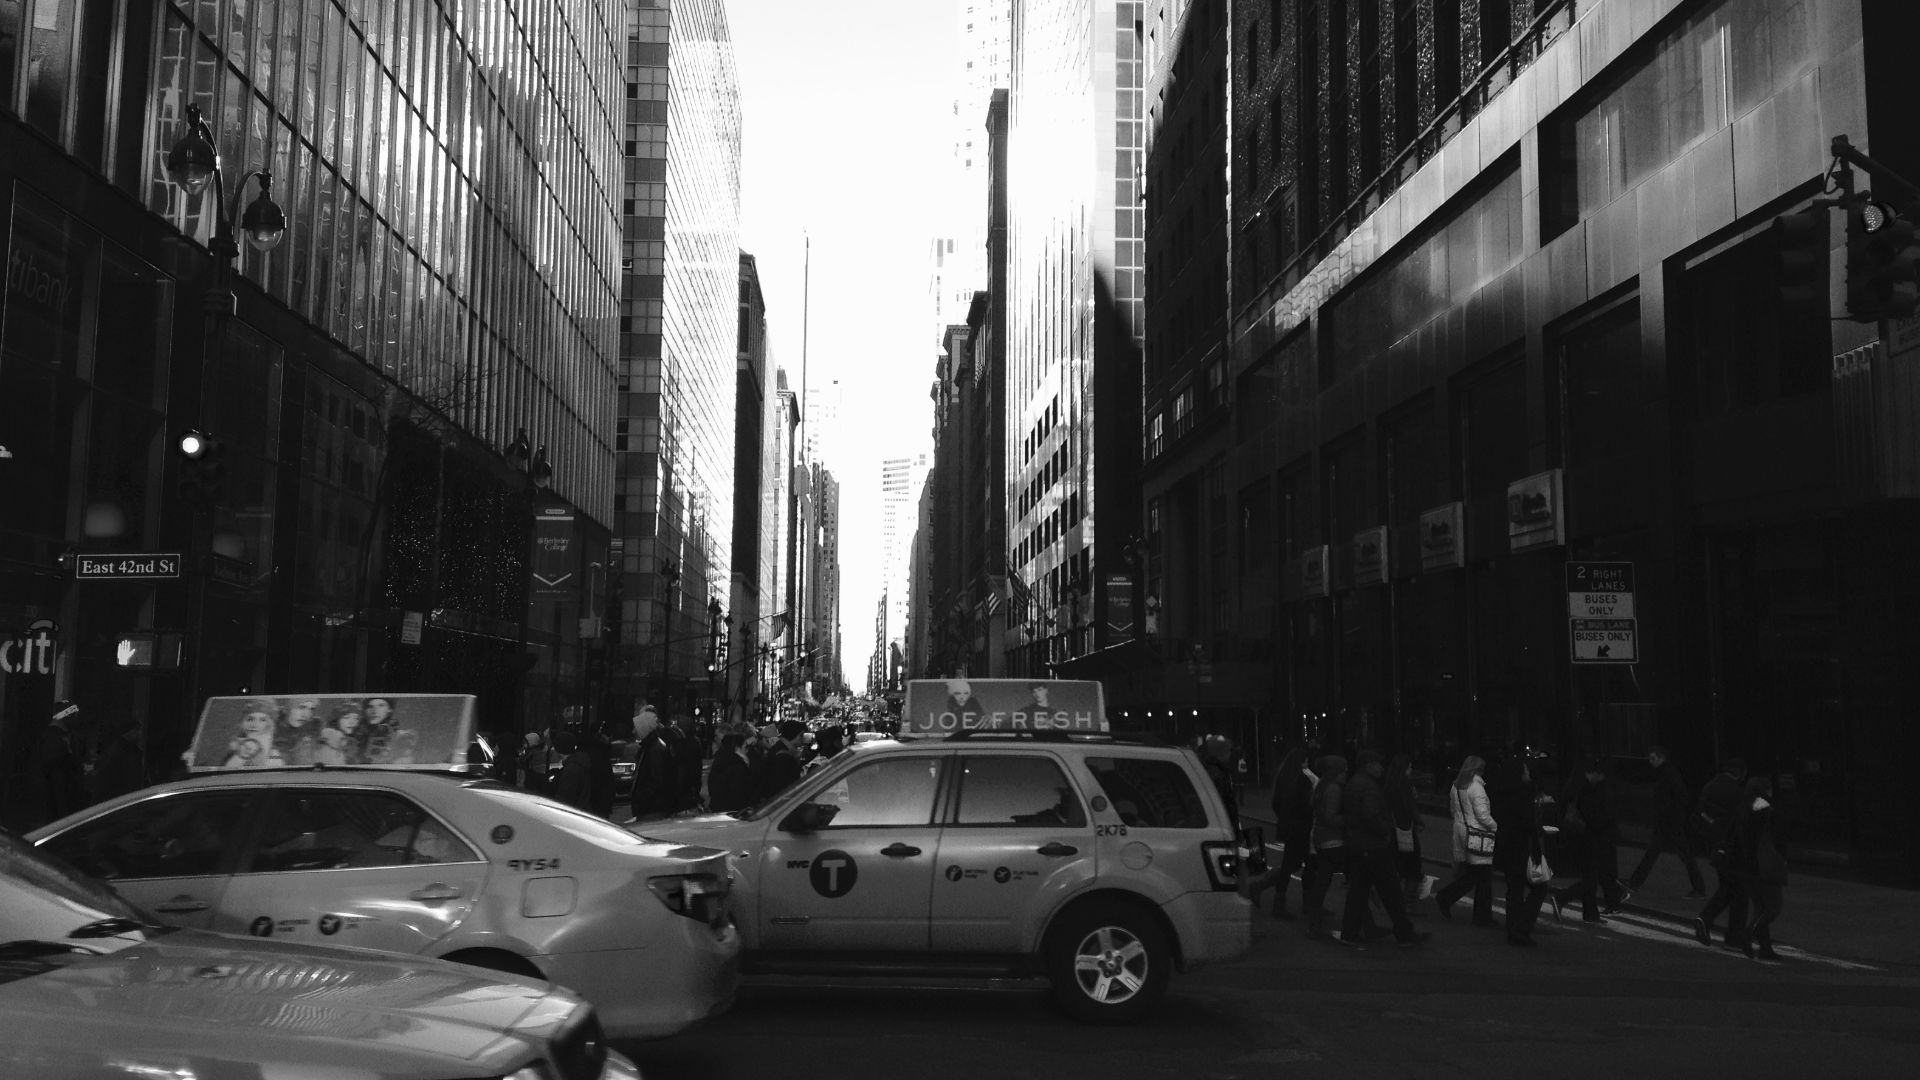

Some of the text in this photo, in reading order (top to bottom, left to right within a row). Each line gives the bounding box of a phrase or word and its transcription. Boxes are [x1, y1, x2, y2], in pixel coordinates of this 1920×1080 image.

[9, 247, 73, 313] tibank
[81, 559, 175, 574] East 42nd St
[1577, 566, 1624, 579] 2 RIGHT
[1591, 581, 1626, 590] LANES
[1584, 594, 1618, 604] BUSES
[1588, 606, 1615, 615] ONLY
[1575, 632, 1632, 641] BUSES ONLY
[919, 711, 1093, 730] JOE FRESH
[1096, 824, 1127, 837] 2K78
[787, 859, 847, 892] NYC T
